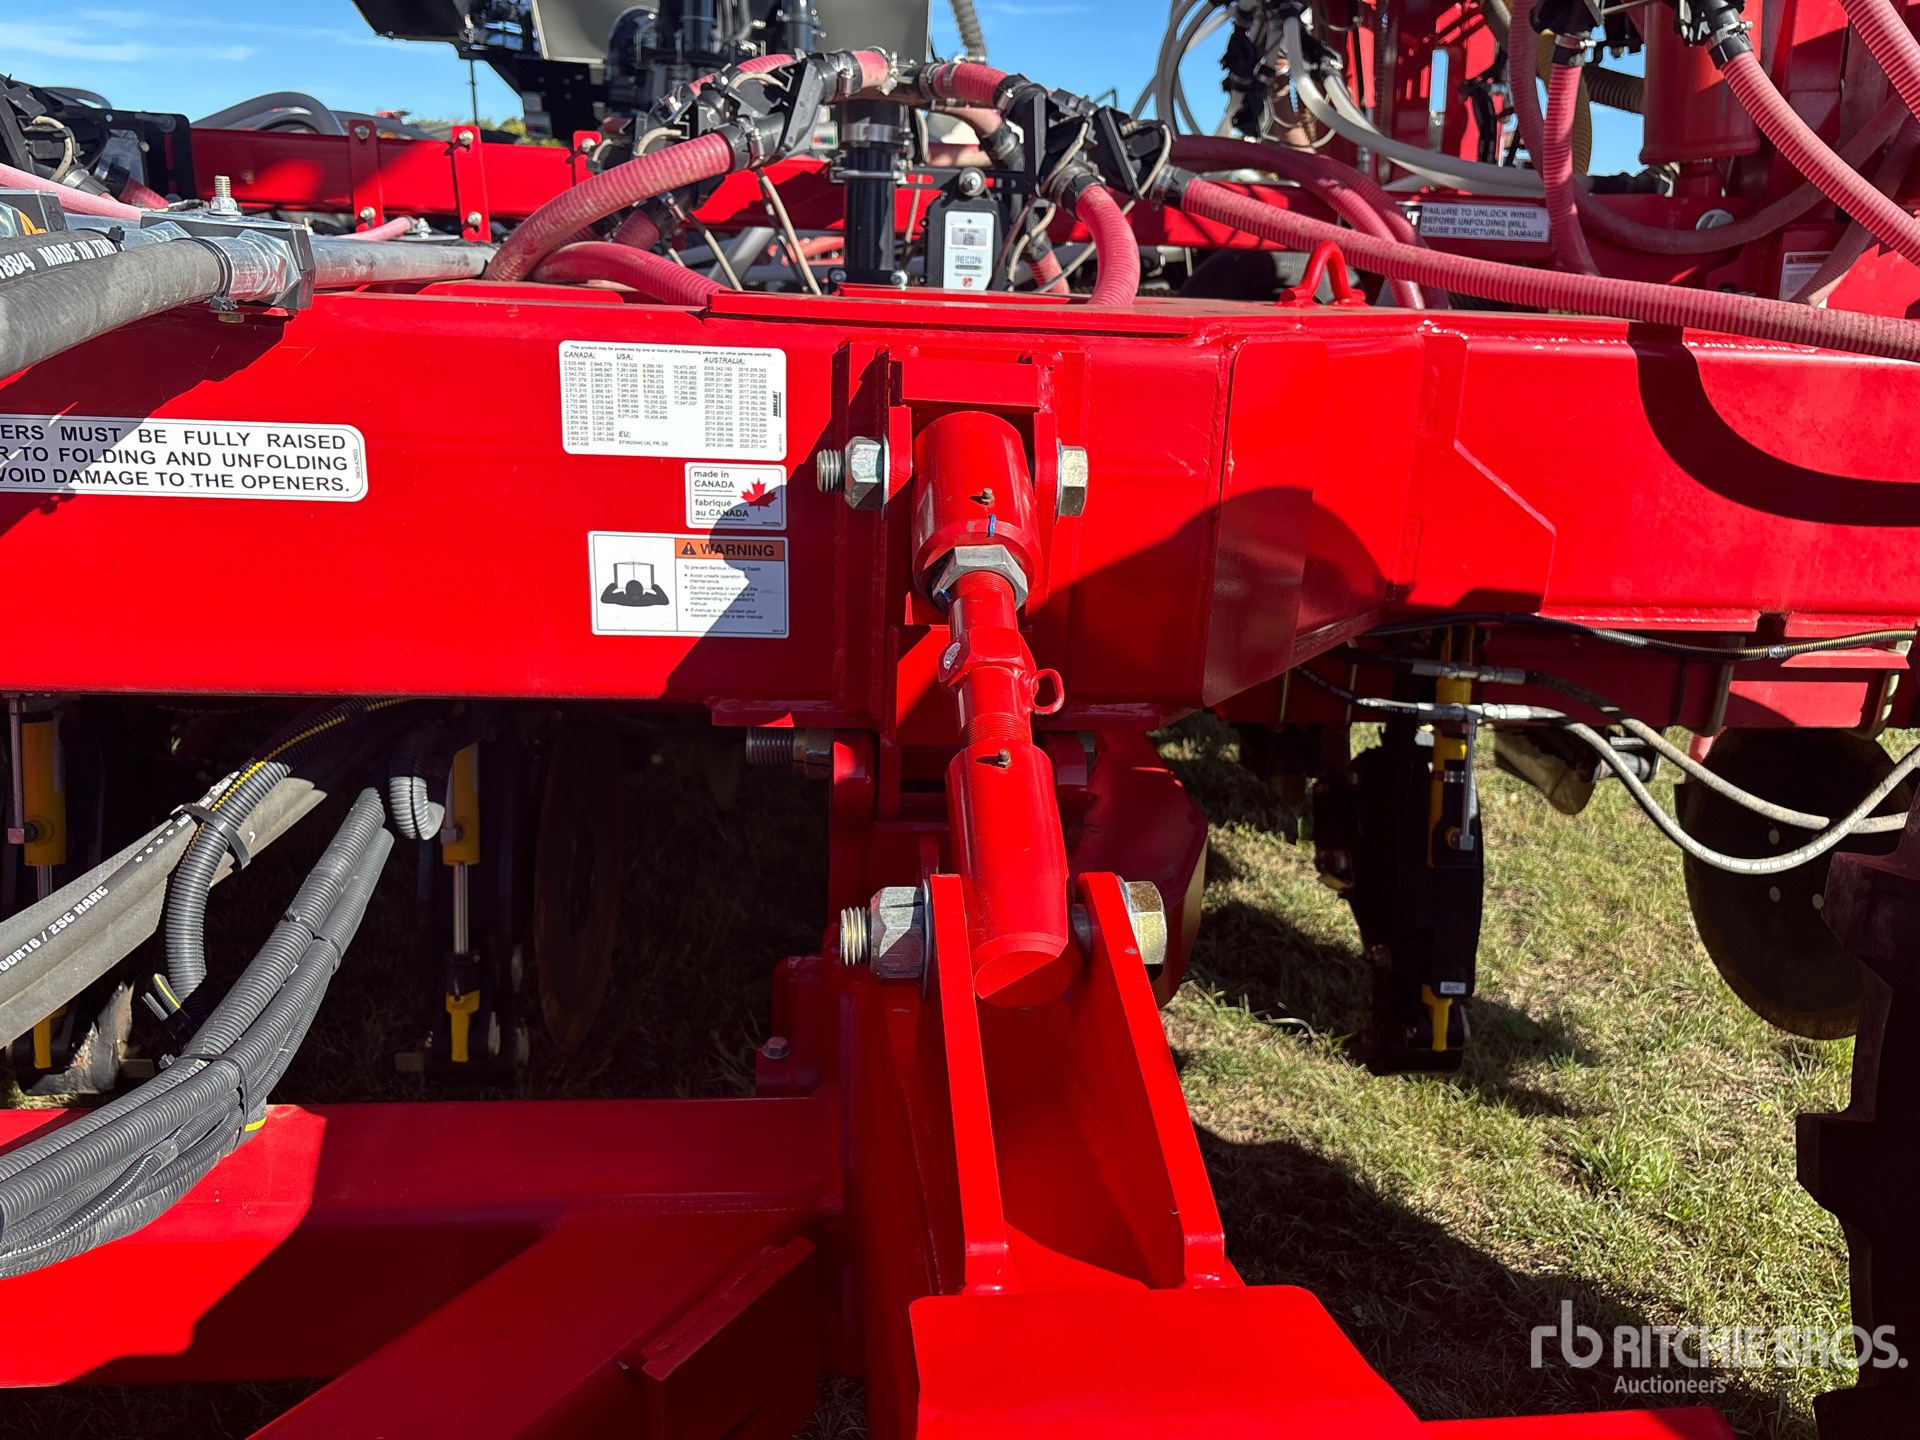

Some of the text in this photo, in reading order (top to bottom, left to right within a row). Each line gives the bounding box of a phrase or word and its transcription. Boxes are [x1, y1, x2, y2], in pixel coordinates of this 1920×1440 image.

[1424, 207, 1538, 219] FAILURE TO UNLOCK WINGS
[1422, 216, 1527, 228] BEFORE UNFOLDING WILL
[1452, 227, 1506, 237] STRUCTURAL
[36, 243, 80, 267] MADE
[73, 240, 96, 260] IN
[0, 424, 346, 450] ERS MUST BE FULLY RAISED
[0, 446, 348, 470] R TO FOLDING AND UNFOLDING
[53, 469, 149, 486] DAMAGE
[155, 472, 184, 486] TO
[191, 473, 234, 488] THE
[241, 475, 350, 492] OPENERS.
[694, 480, 735, 488] CANADA
[695, 498, 731, 508] fabriqué
[709, 509, 749, 517] CANADA
[700, 544, 774, 556] WARNING
[41, 930, 48, 942] /
[48, 912, 75, 935] 2SC
[73, 886, 108, 915] HARC
